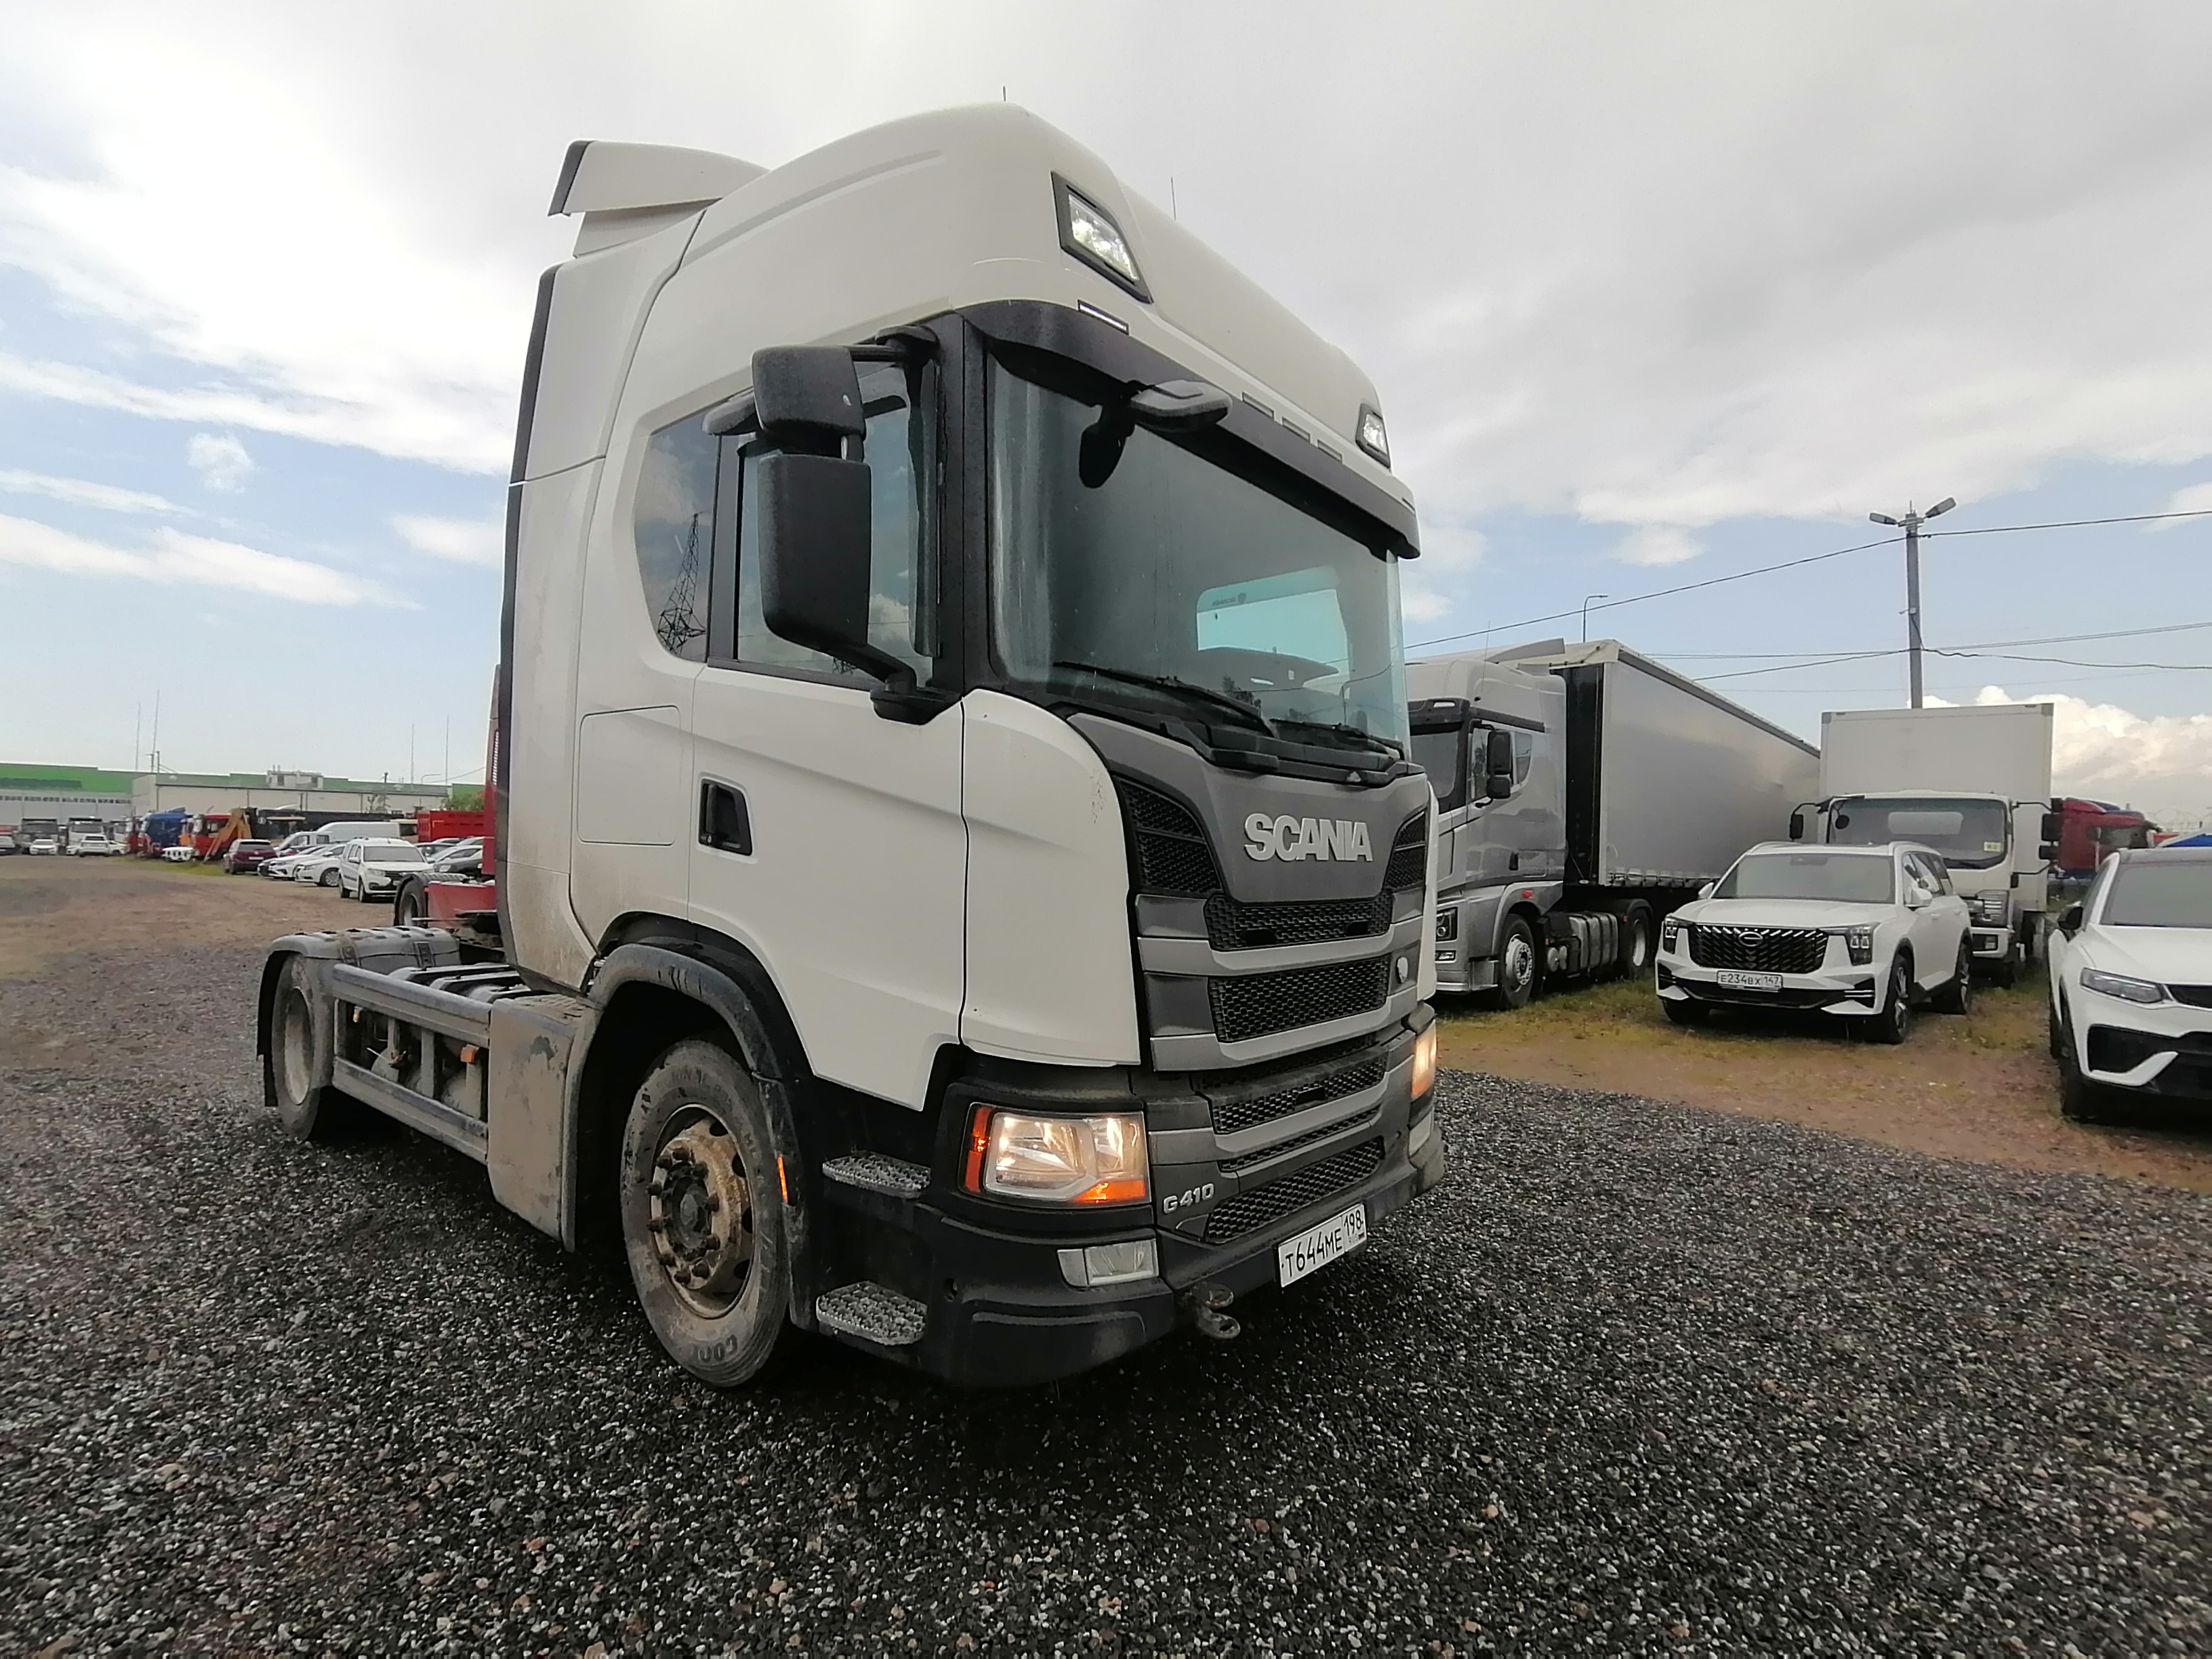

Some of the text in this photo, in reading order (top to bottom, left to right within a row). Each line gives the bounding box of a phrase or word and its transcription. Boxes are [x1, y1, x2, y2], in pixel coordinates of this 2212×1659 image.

[1244, 813, 1374, 863] SCANIA
[1763, 976, 1779, 985] 147
[1164, 1183, 1214, 1214] G410
[1344, 1209, 1362, 1237] 198
